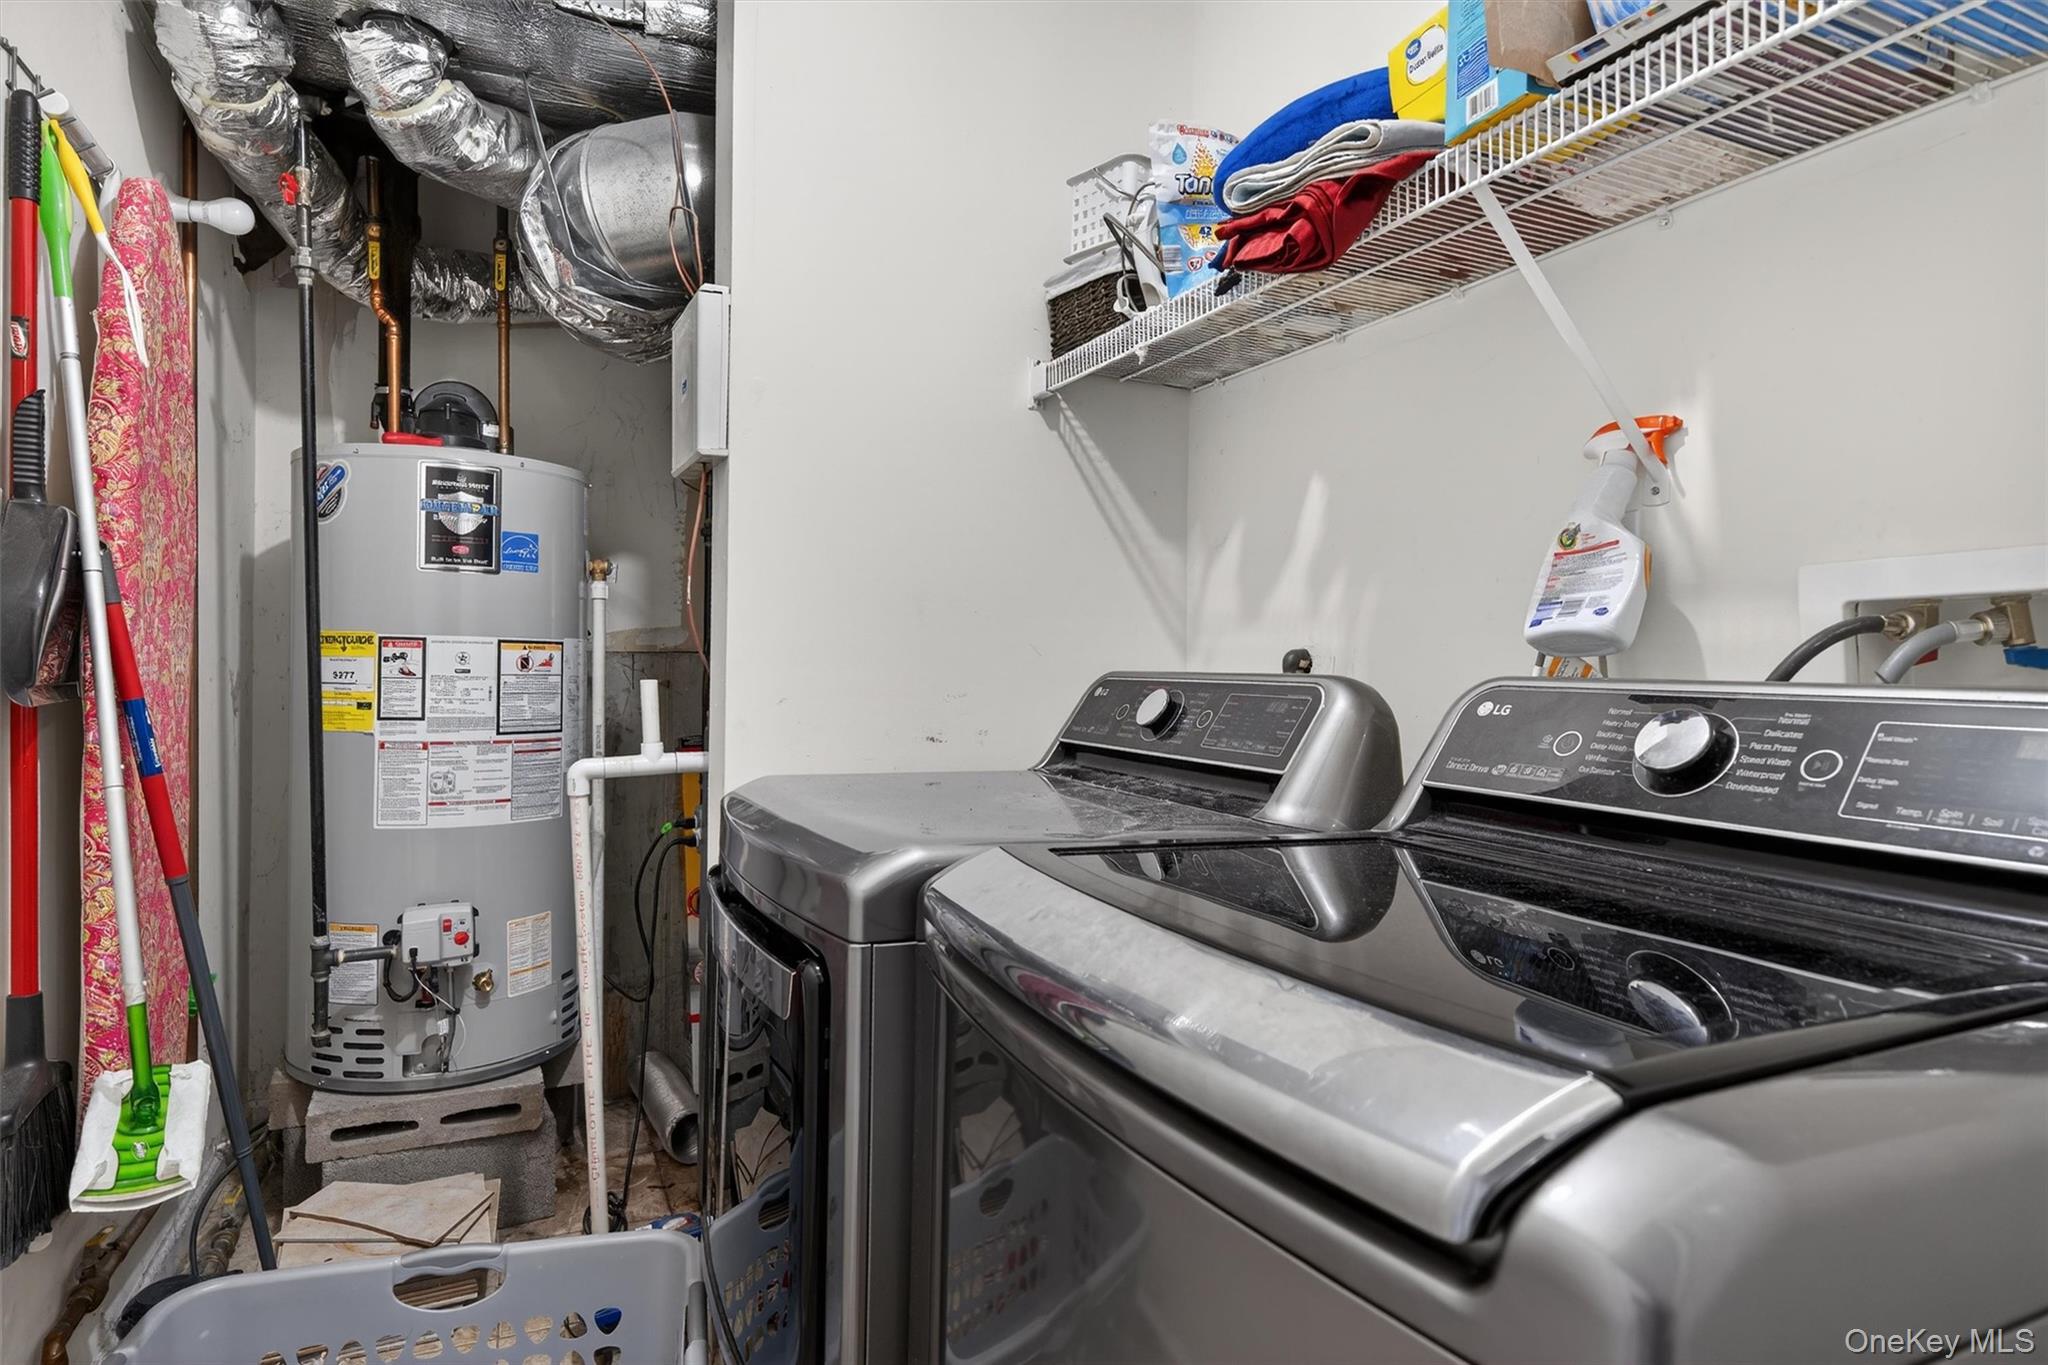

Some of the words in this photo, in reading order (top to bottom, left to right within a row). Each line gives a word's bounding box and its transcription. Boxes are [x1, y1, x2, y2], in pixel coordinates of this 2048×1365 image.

[1174, 173, 1214, 195] Tan
[332, 671, 355, 680] $277
[1493, 704, 1512, 716] LG
[1778, 716, 1812, 726] Normal
[1763, 728, 1804, 740] Delicates
[1766, 757, 1792, 767] Wash
[1735, 768, 1786, 780] Waterproof
[1725, 781, 1780, 795] Downloaded
